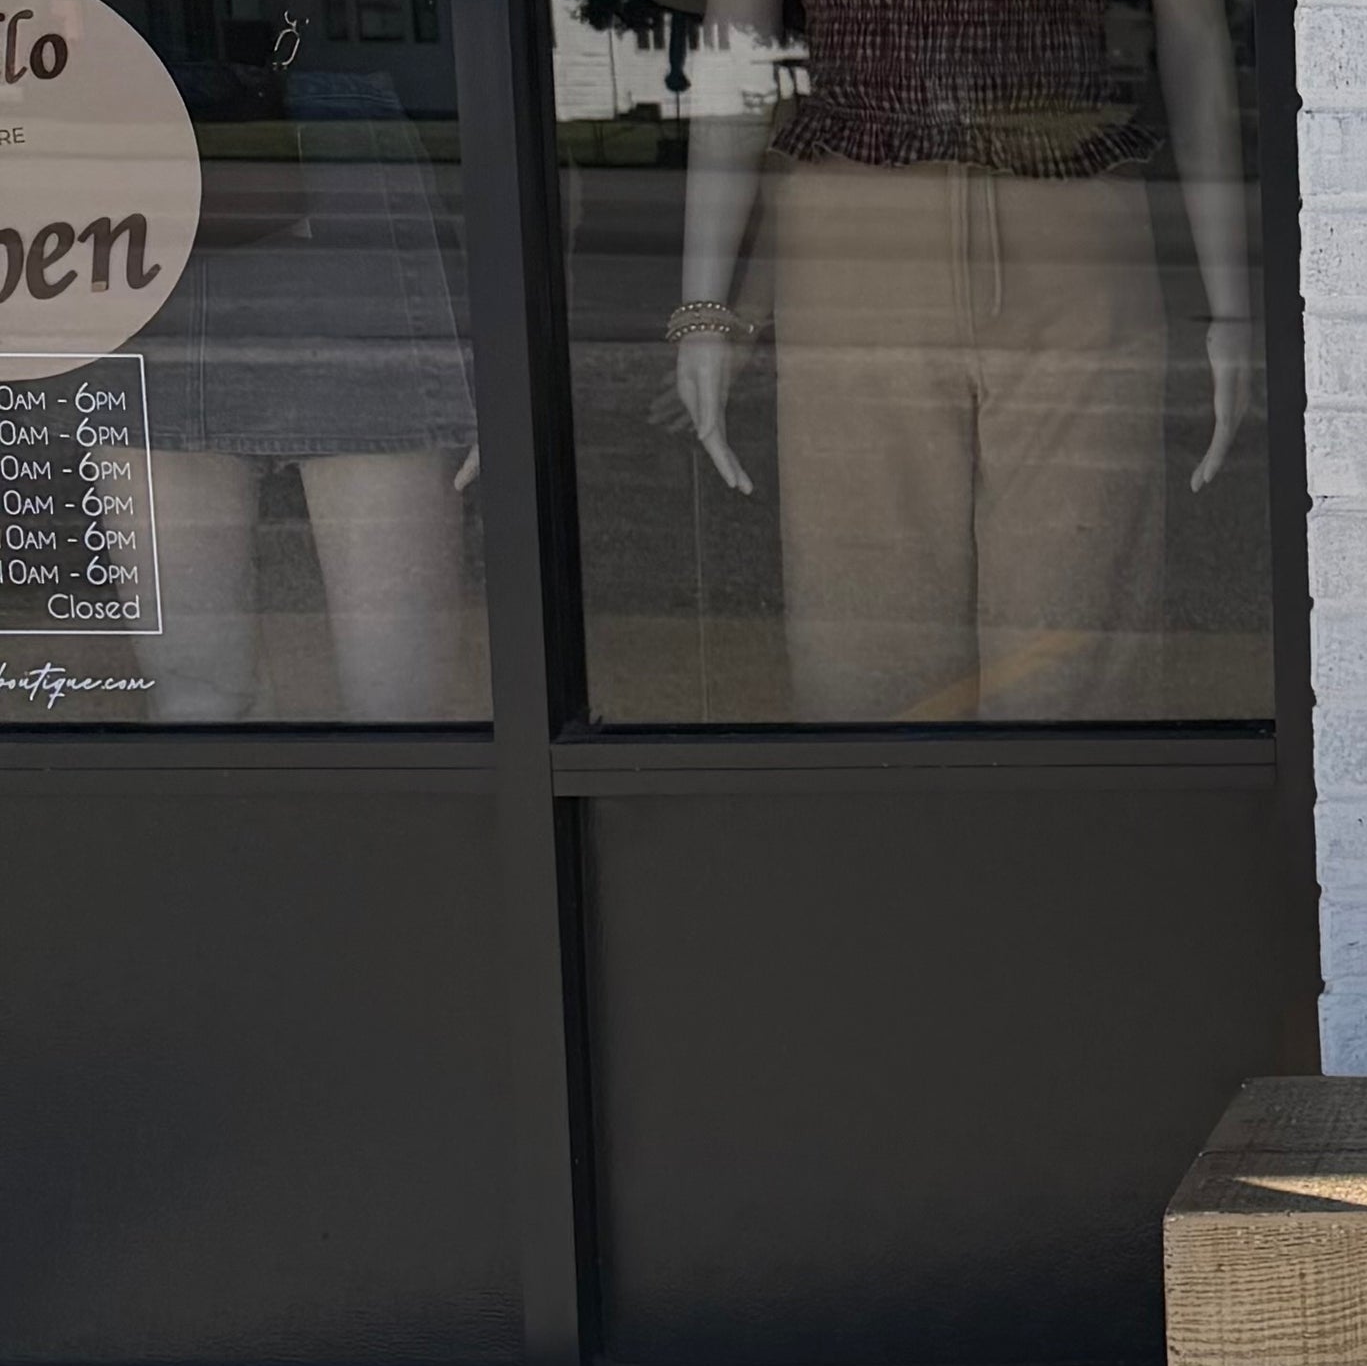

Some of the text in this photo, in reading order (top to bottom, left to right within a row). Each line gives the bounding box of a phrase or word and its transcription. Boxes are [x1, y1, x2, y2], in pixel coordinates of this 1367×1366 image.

[0, 9, 68, 84] lo
[75, 382, 126, 413] 6PM
[76, 417, 129, 447] 6PM
[79, 452, 131, 482] 6PM
[82, 487, 134, 517] 6PM
[0, 525, 57, 550] 0AM
[84, 521, 137, 551] 6PM
[87, 555, 139, 586] 6PM
[48, 593, 140, 619] Closed
